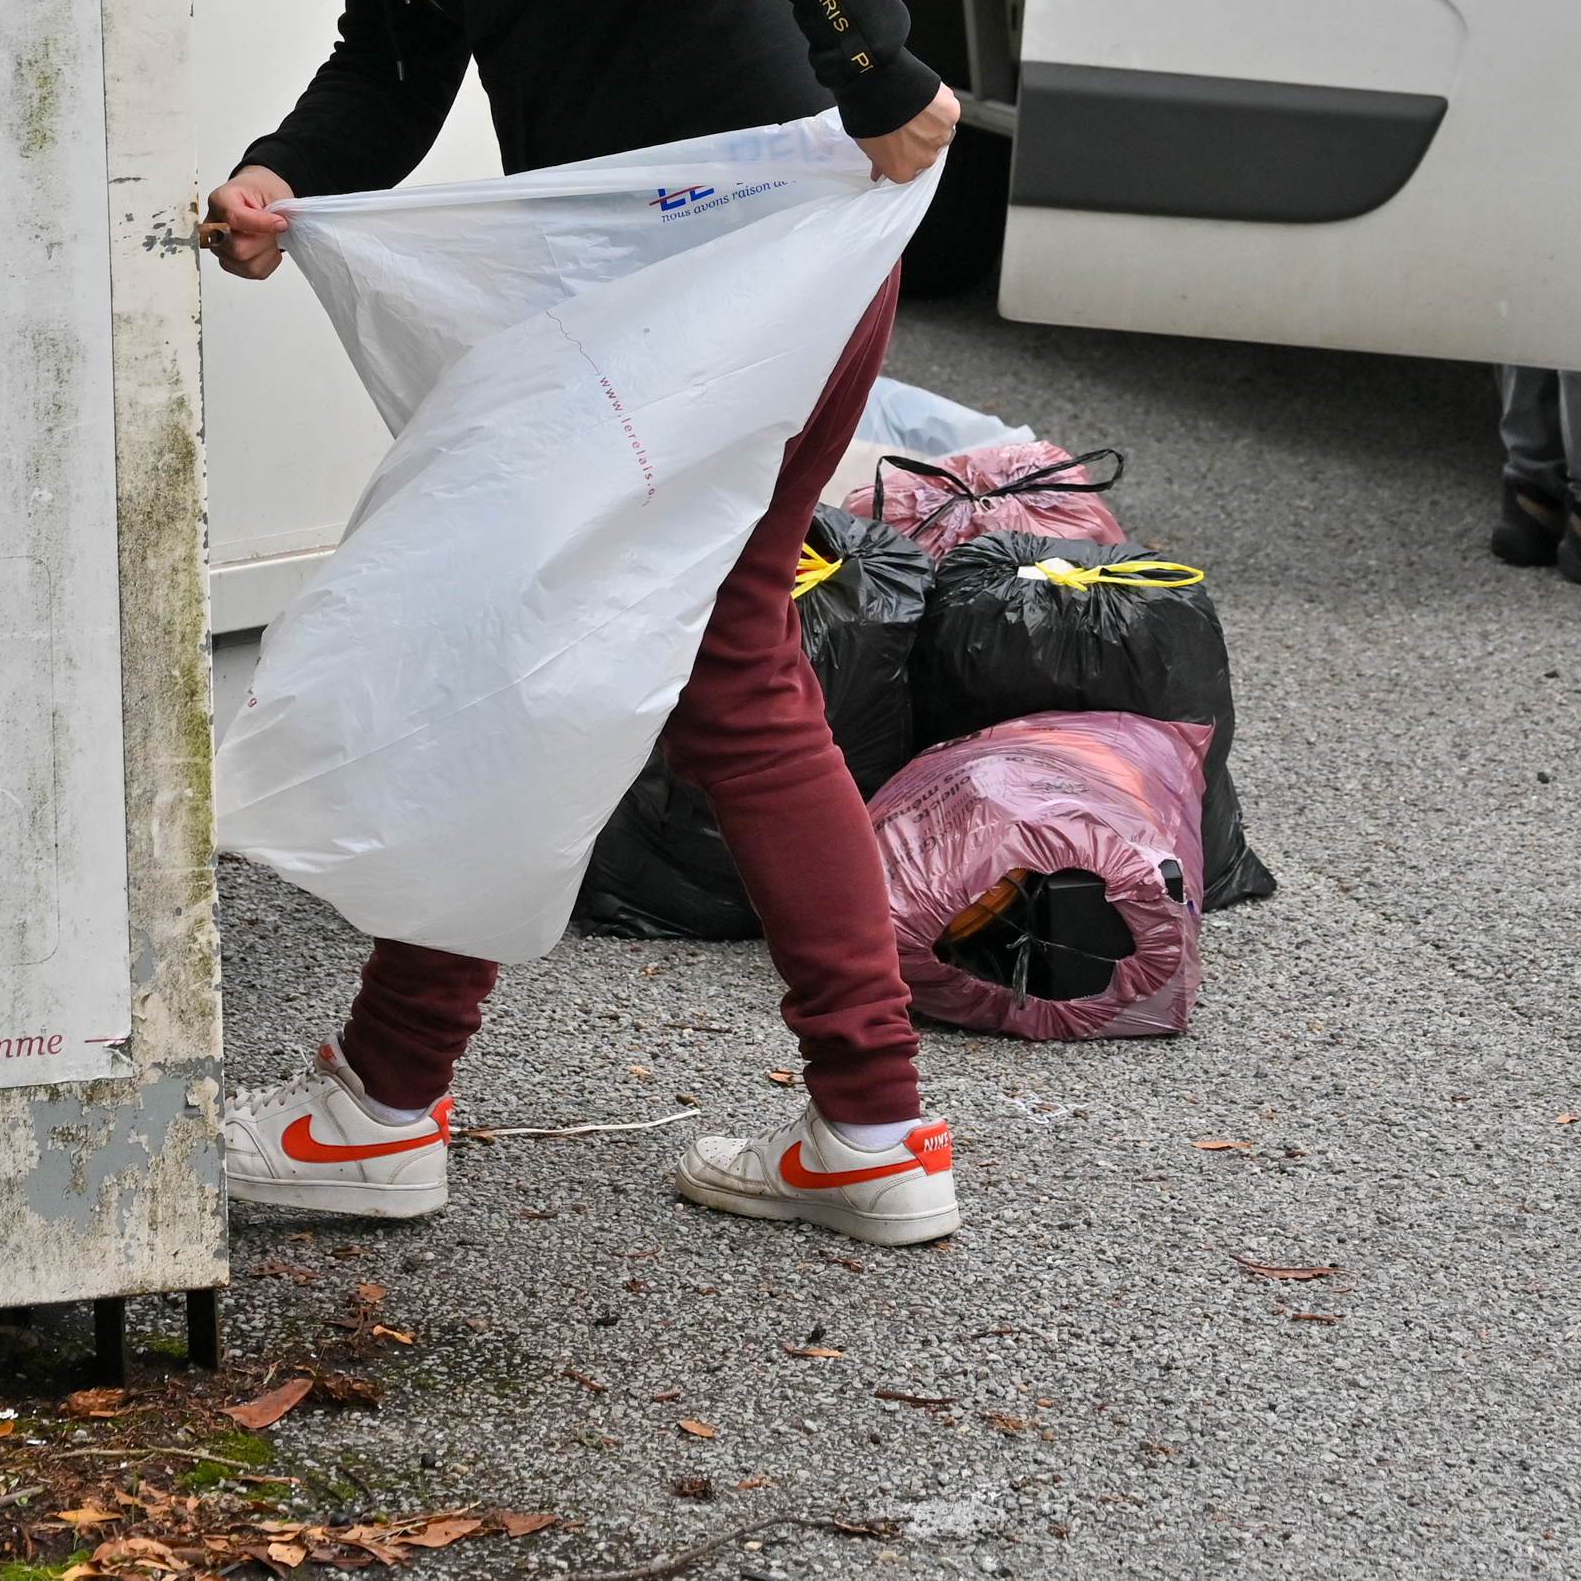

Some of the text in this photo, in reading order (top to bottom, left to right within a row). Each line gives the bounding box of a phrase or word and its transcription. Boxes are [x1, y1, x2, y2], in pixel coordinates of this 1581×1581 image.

[661, 182, 771, 223] nous avons raison
[599, 376, 656, 507] www.lerelais.o
[923, 1131, 949, 1152] NIKE
